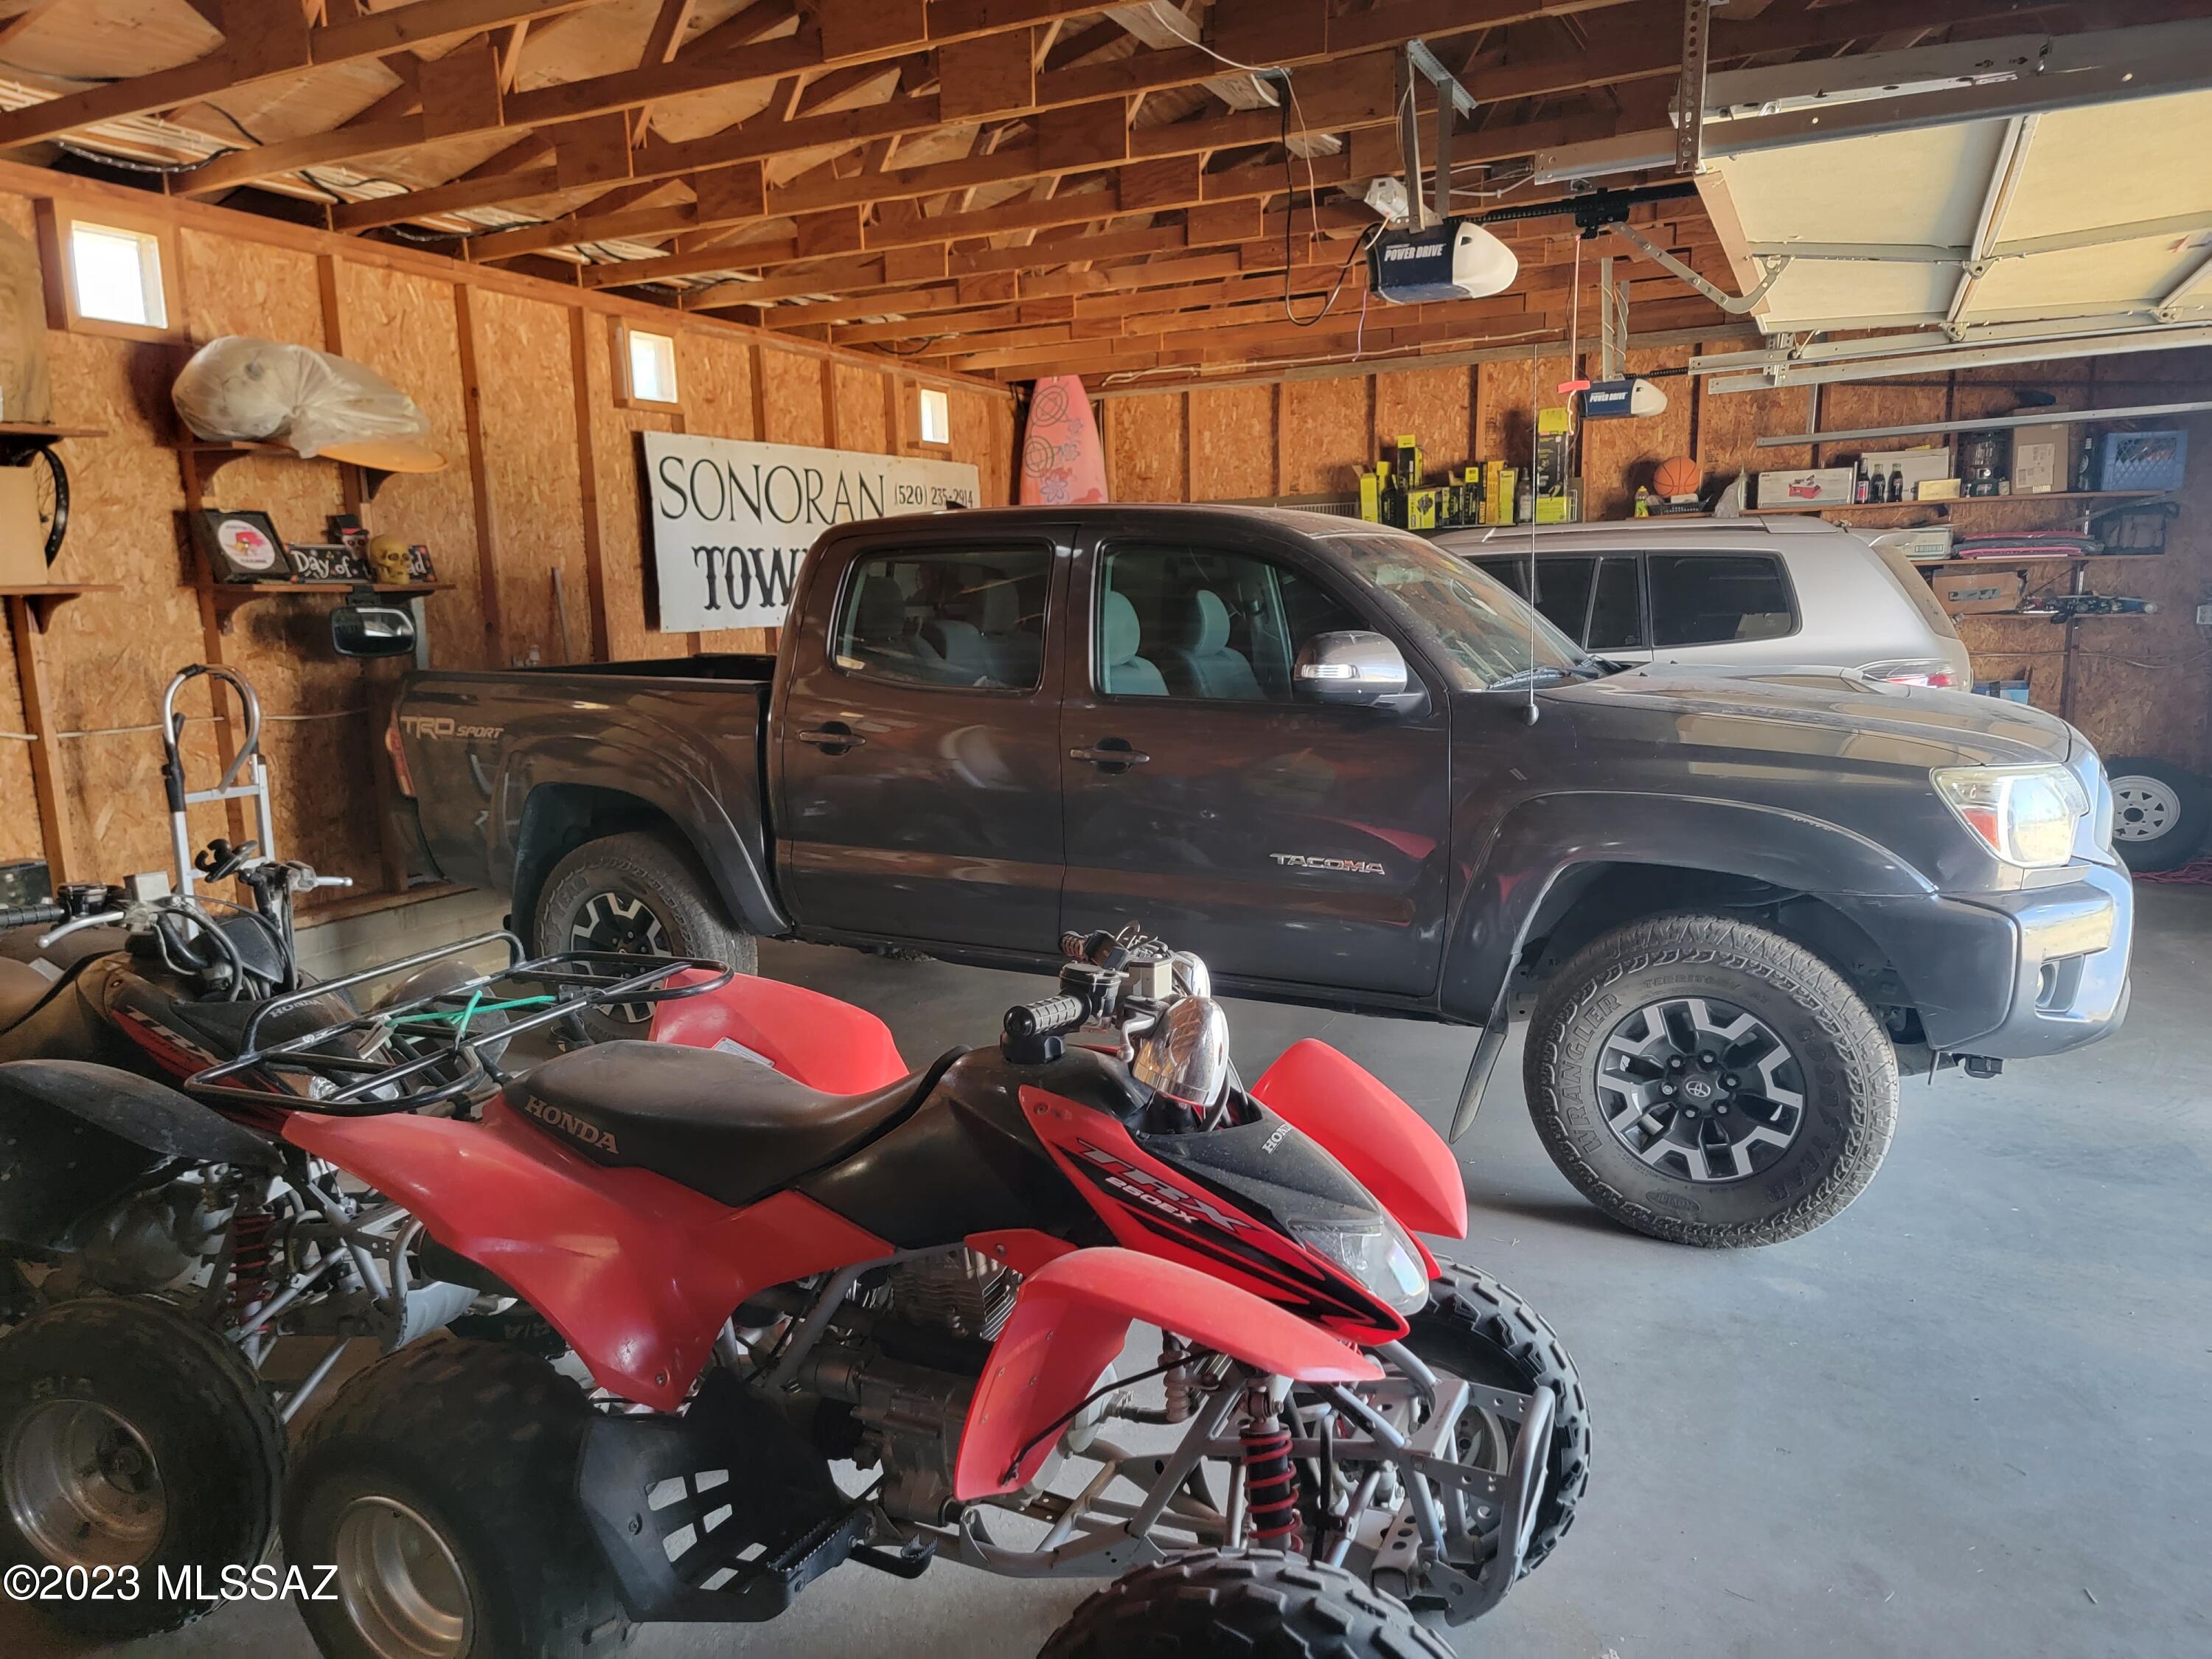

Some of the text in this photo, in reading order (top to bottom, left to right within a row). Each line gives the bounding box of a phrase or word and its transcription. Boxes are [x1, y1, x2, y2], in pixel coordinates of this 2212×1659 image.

[1384, 246, 1416, 262] POWER
[1416, 243, 1446, 259] DRIVE
[1589, 392, 1628, 403] POWER DRIVE
[659, 456, 884, 526] SONORAN
[894, 483, 928, 507] (520)
[291, 551, 330, 579] Day
[335, 555, 352, 577] of
[692, 546, 808, 611] TOW
[456, 725, 504, 738] SPORT
[1269, 852, 1385, 875] TACOMA
[1562, 993, 1622, 1154] WRANGLER
[524, 1094, 619, 1155] HONDA
[1768, 1027, 1843, 1203] GOODYEAR
[1077, 1138, 1253, 1234] TRX
[1105, 1176, 1199, 1224] 250EX
